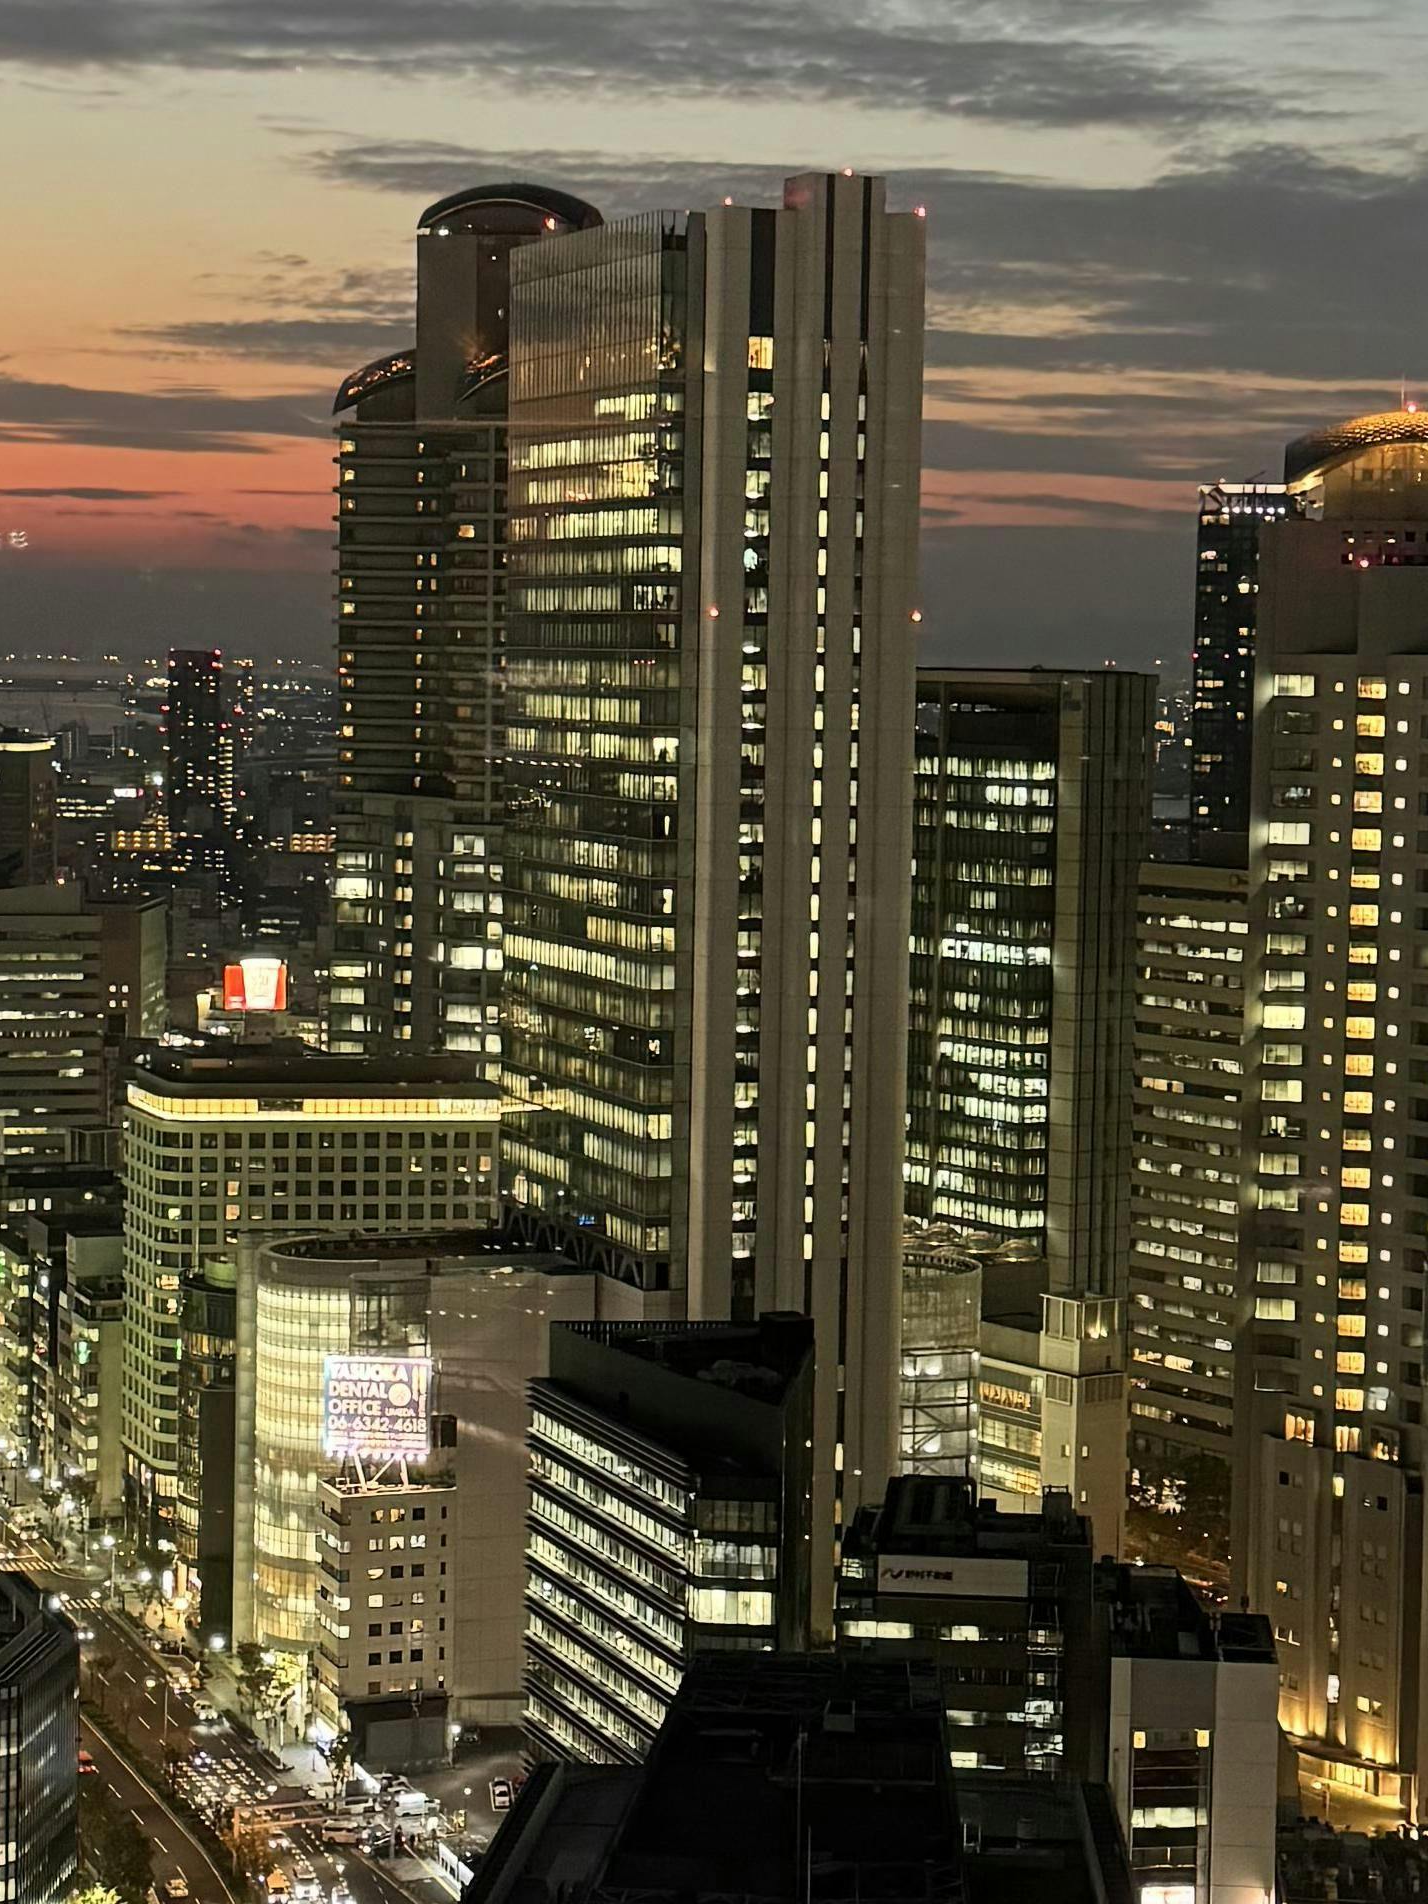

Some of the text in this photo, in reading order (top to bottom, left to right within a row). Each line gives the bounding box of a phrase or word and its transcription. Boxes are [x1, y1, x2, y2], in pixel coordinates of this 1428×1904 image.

[328, 1381, 388, 1399] DENTAL
[328, 1399, 416, 1417] OFFICE UMEDA
